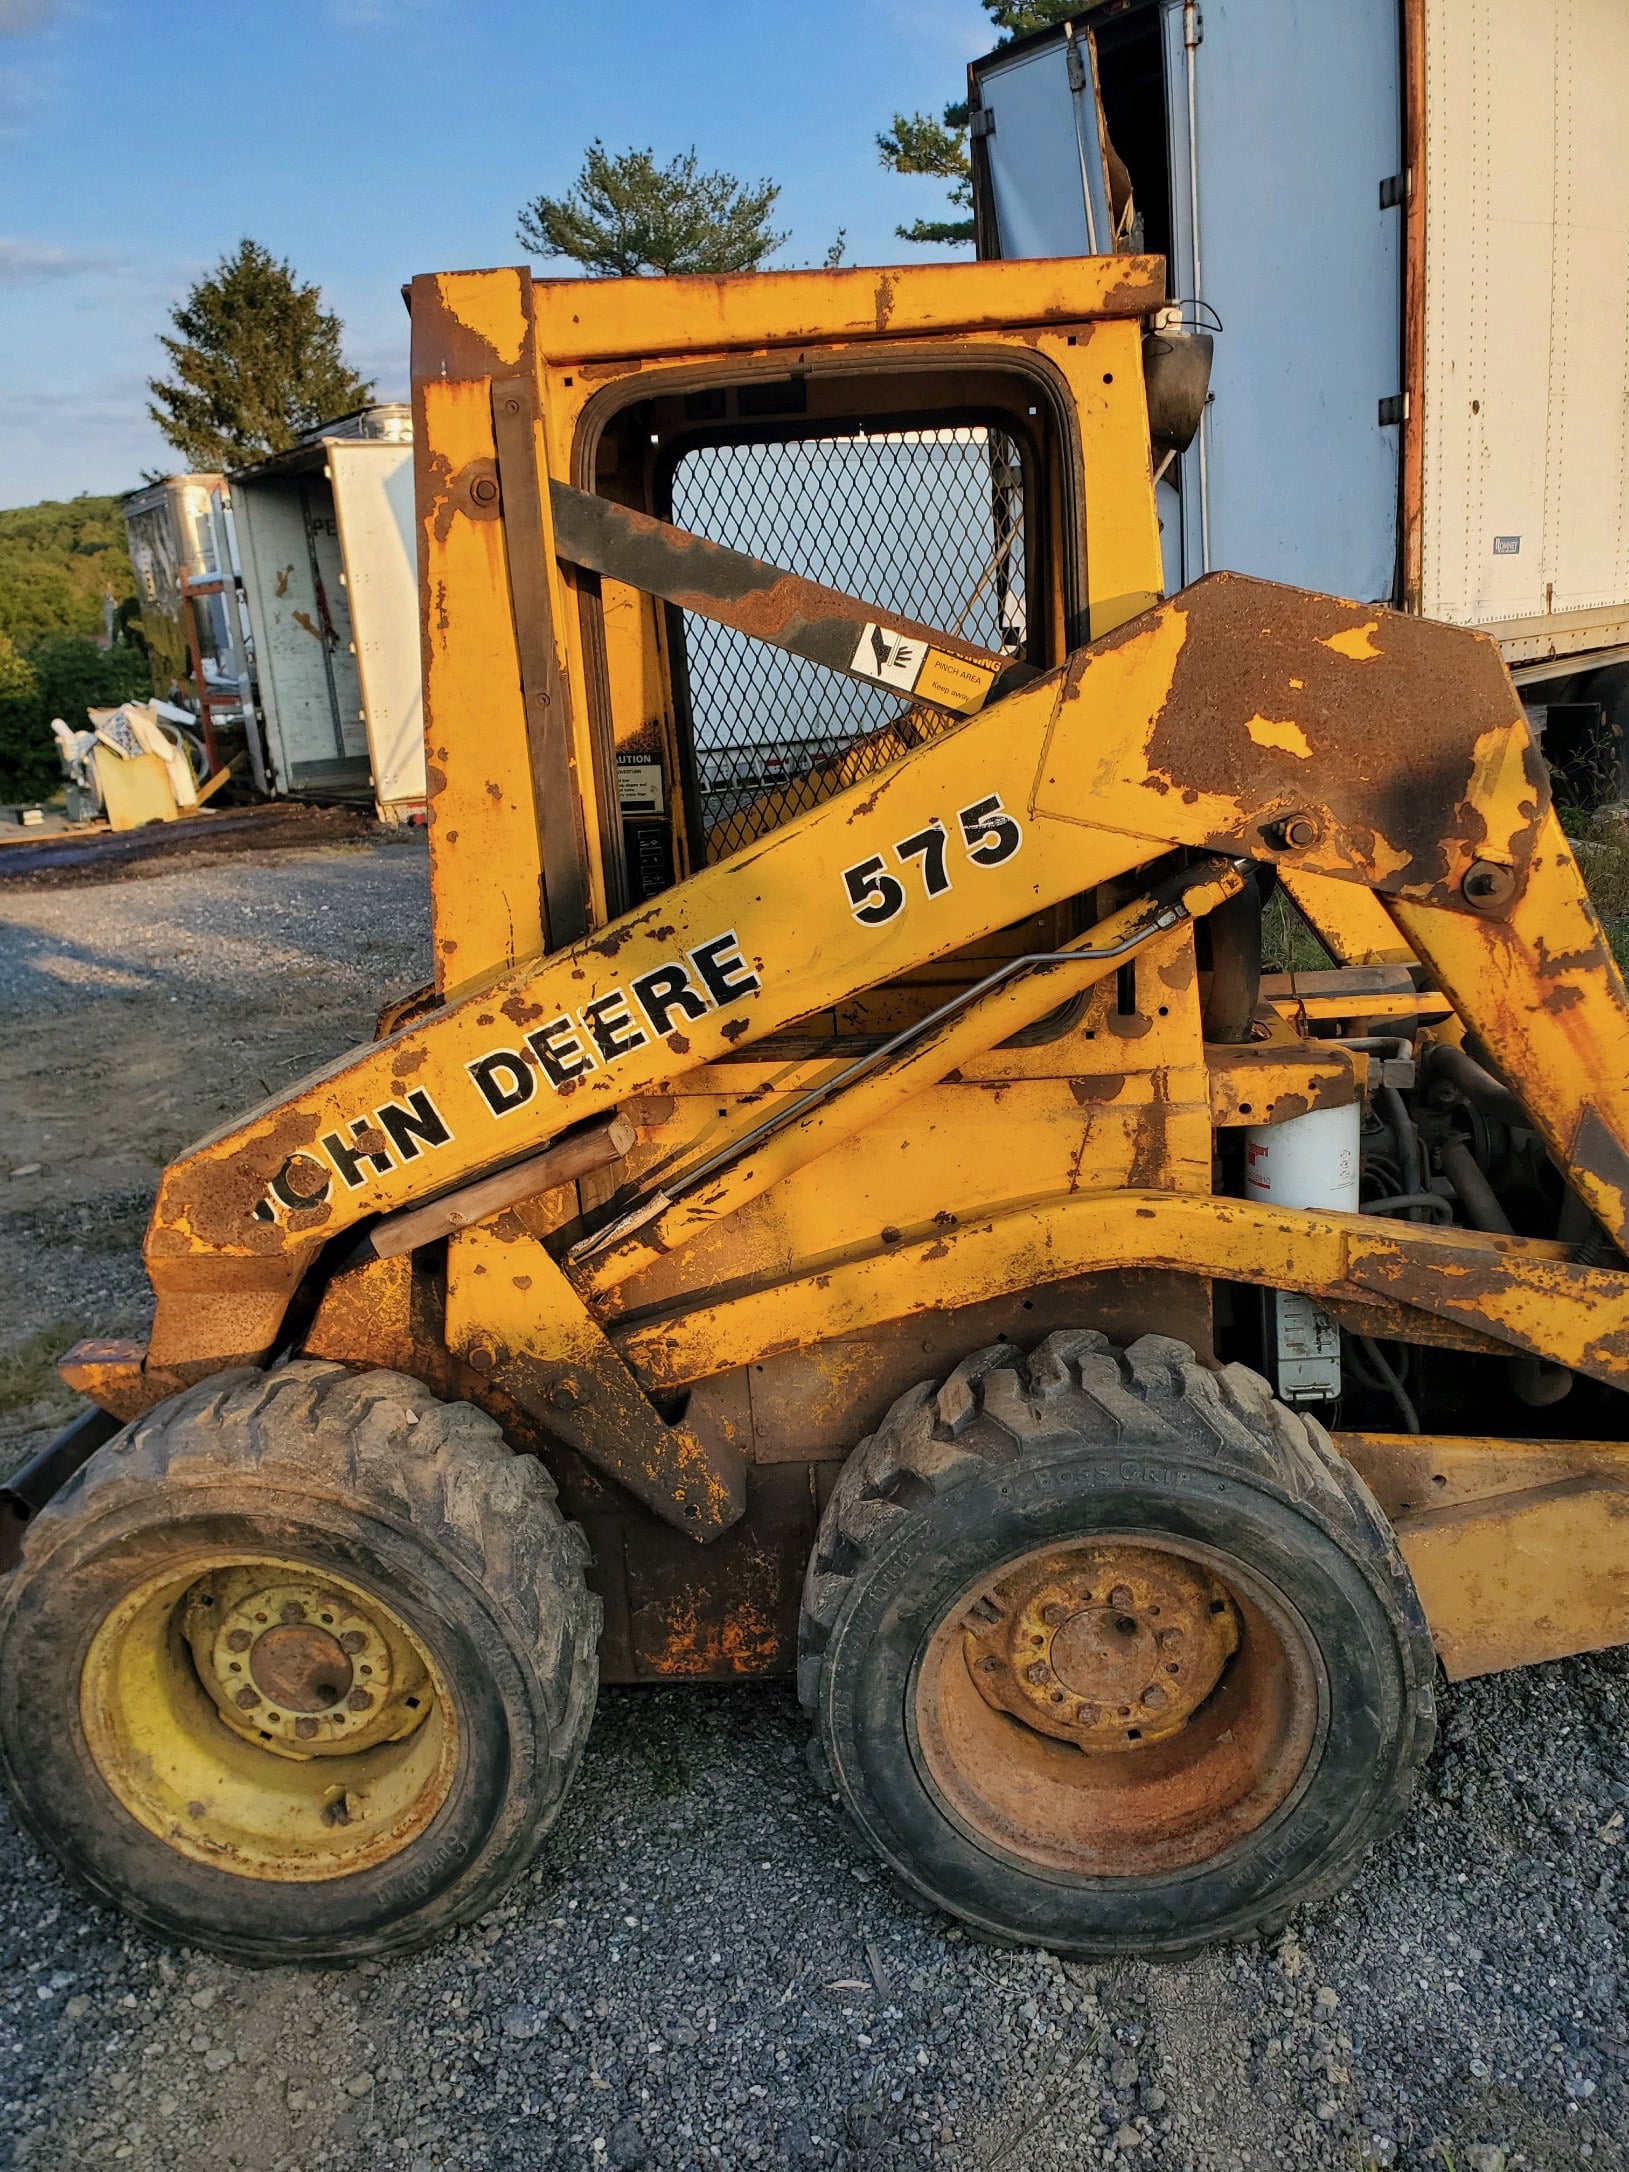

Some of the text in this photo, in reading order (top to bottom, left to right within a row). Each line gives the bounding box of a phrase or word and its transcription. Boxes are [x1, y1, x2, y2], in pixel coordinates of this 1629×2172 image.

[934, 660, 981, 685] PINCH AREA
[931, 680, 971, 703] Keep away
[616, 754, 651, 764] UTION
[840, 791, 1023, 927] 575
[252, 928, 763, 1224] OHN DEERE
